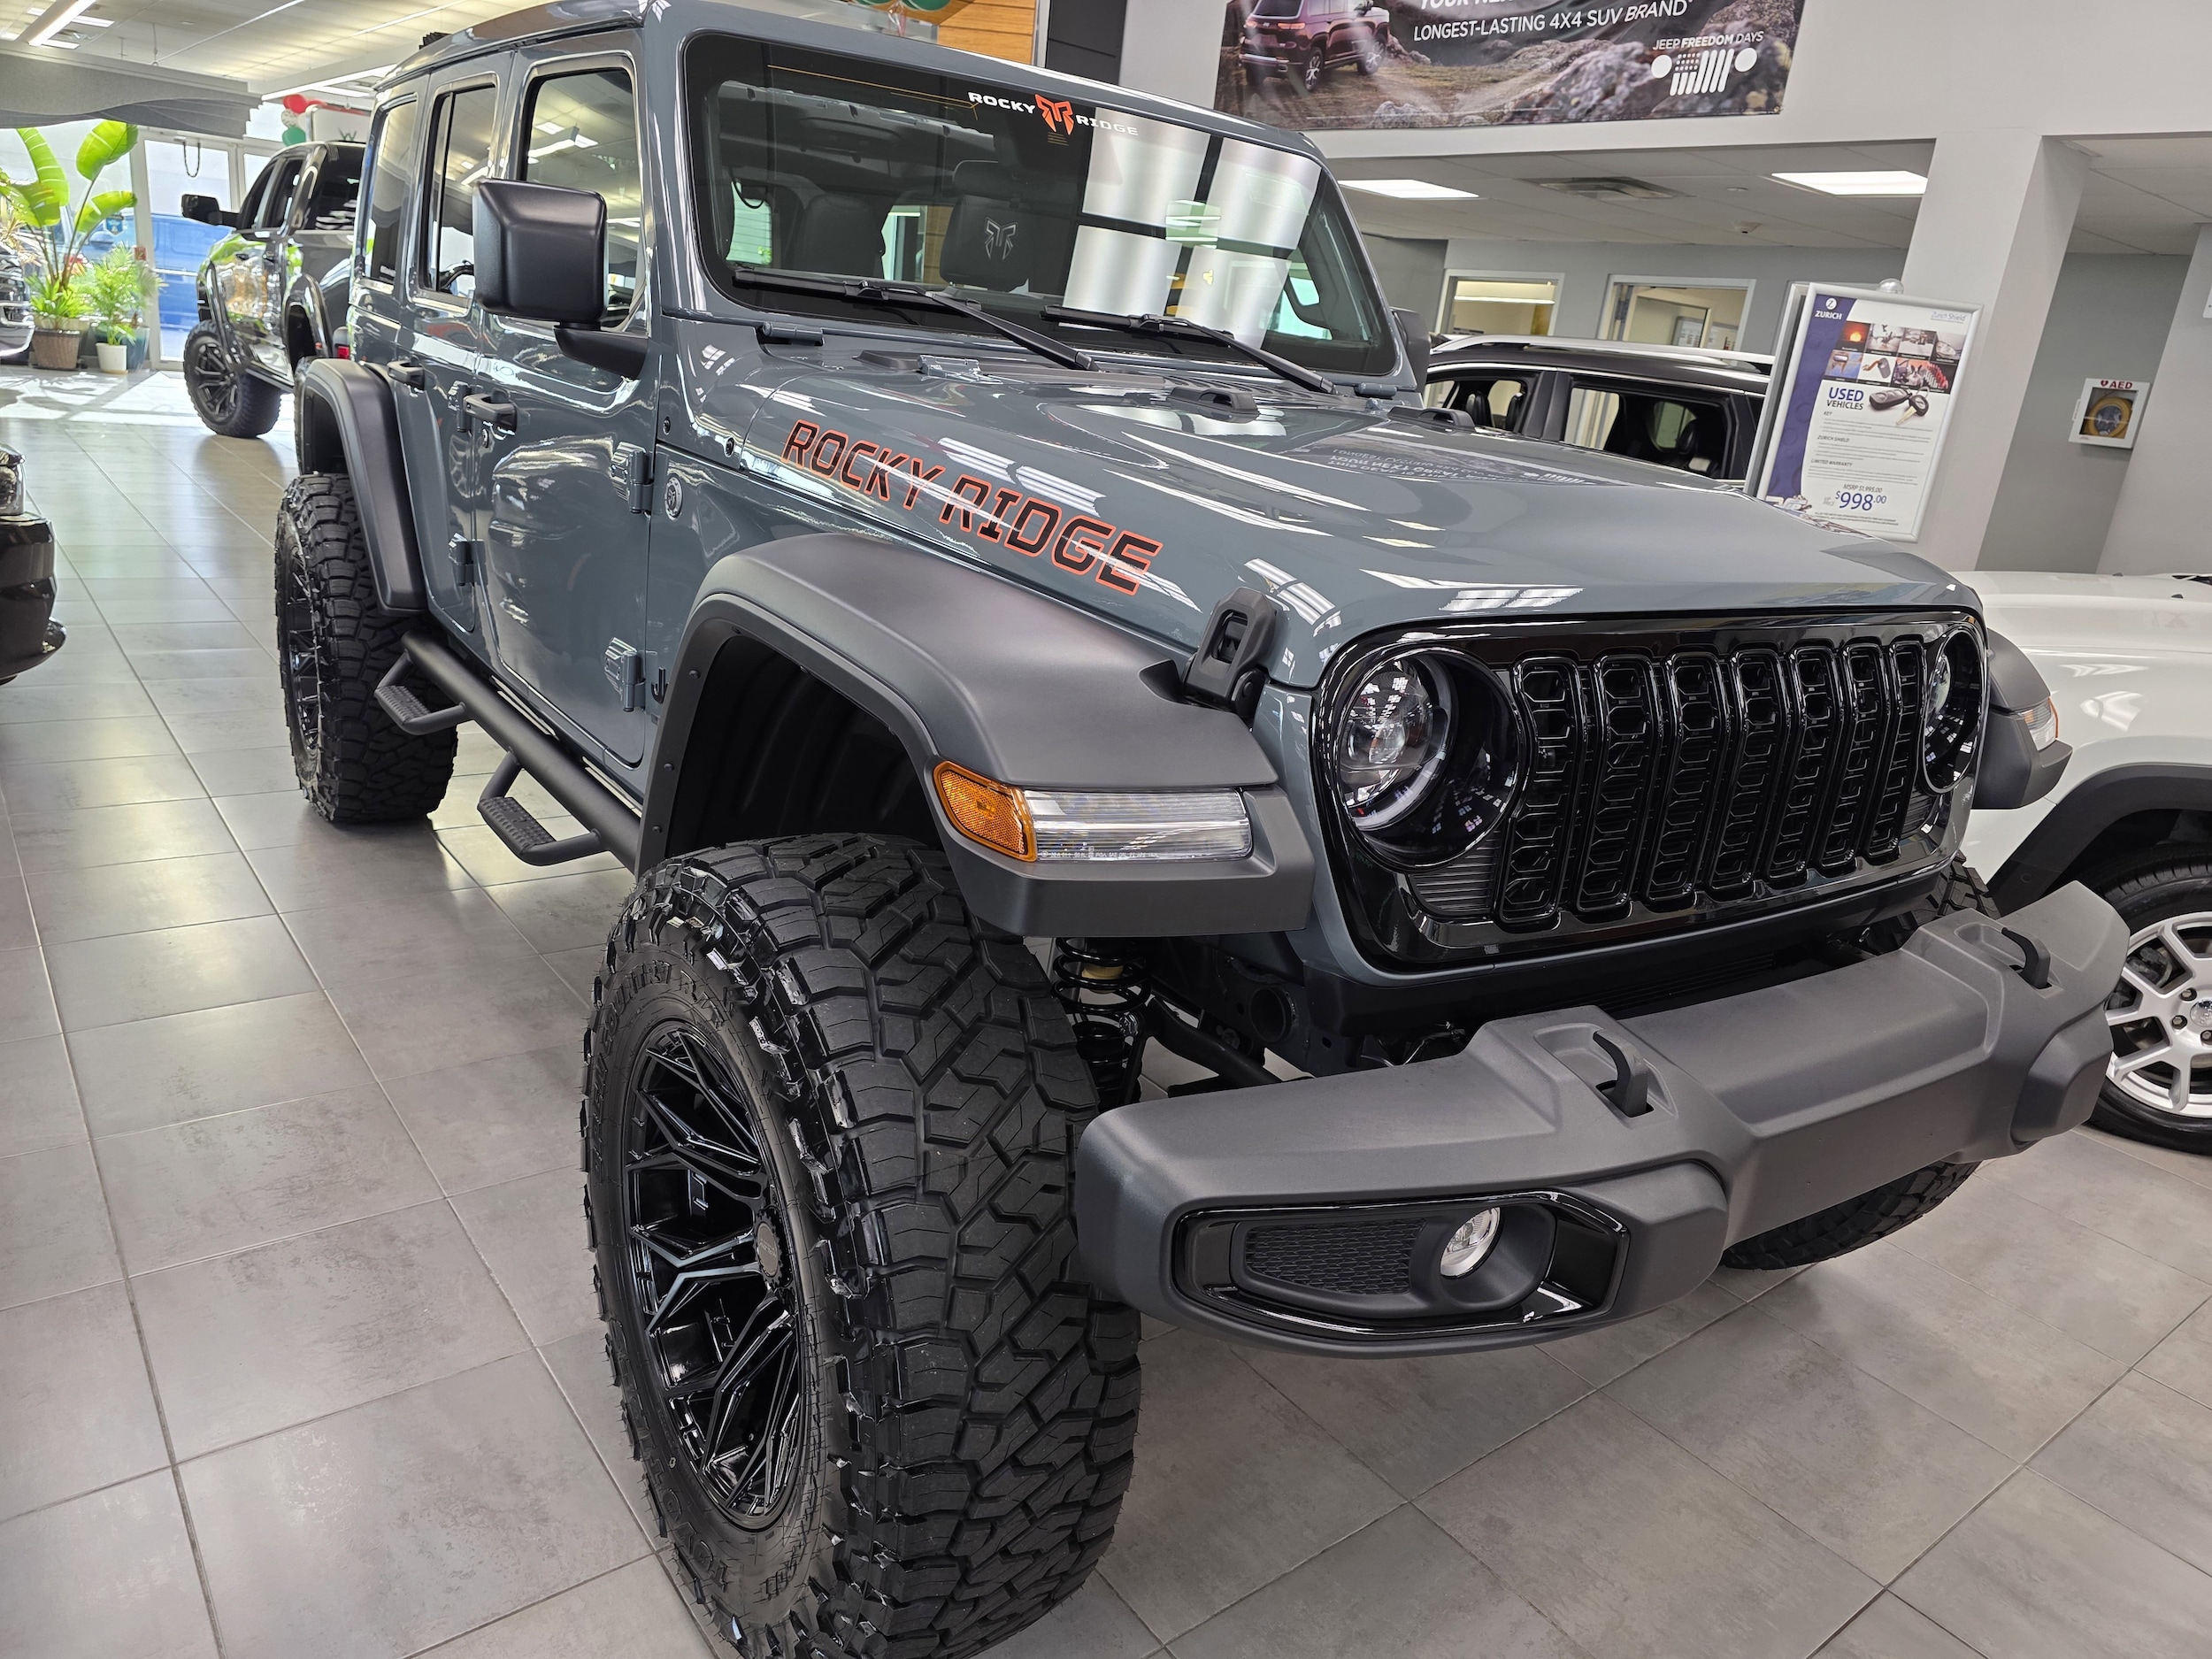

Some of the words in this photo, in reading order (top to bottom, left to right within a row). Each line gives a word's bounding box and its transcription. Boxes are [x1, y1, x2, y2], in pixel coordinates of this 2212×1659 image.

[1413, 13, 1546, 42] LONGEST-LASTING
[1549, 12, 1582, 29] 4X4
[1586, 8, 1624, 27] SUV
[1653, 38, 1681, 50] JEEP
[1681, 35, 1734, 49] FREEDOM
[1735, 31, 1764, 43] DAYS
[968, 91, 1035, 114] ROCKY
[1075, 114, 1139, 136] RIDGE
[1815, 311, 1842, 320] ZURICH
[2109, 380, 2133, 389] AED
[1828, 387, 1864, 402] USED
[1826, 400, 1864, 411] VEHICLES
[780, 419, 945, 511] ROCKY
[939, 473, 1164, 595] RIDGE
